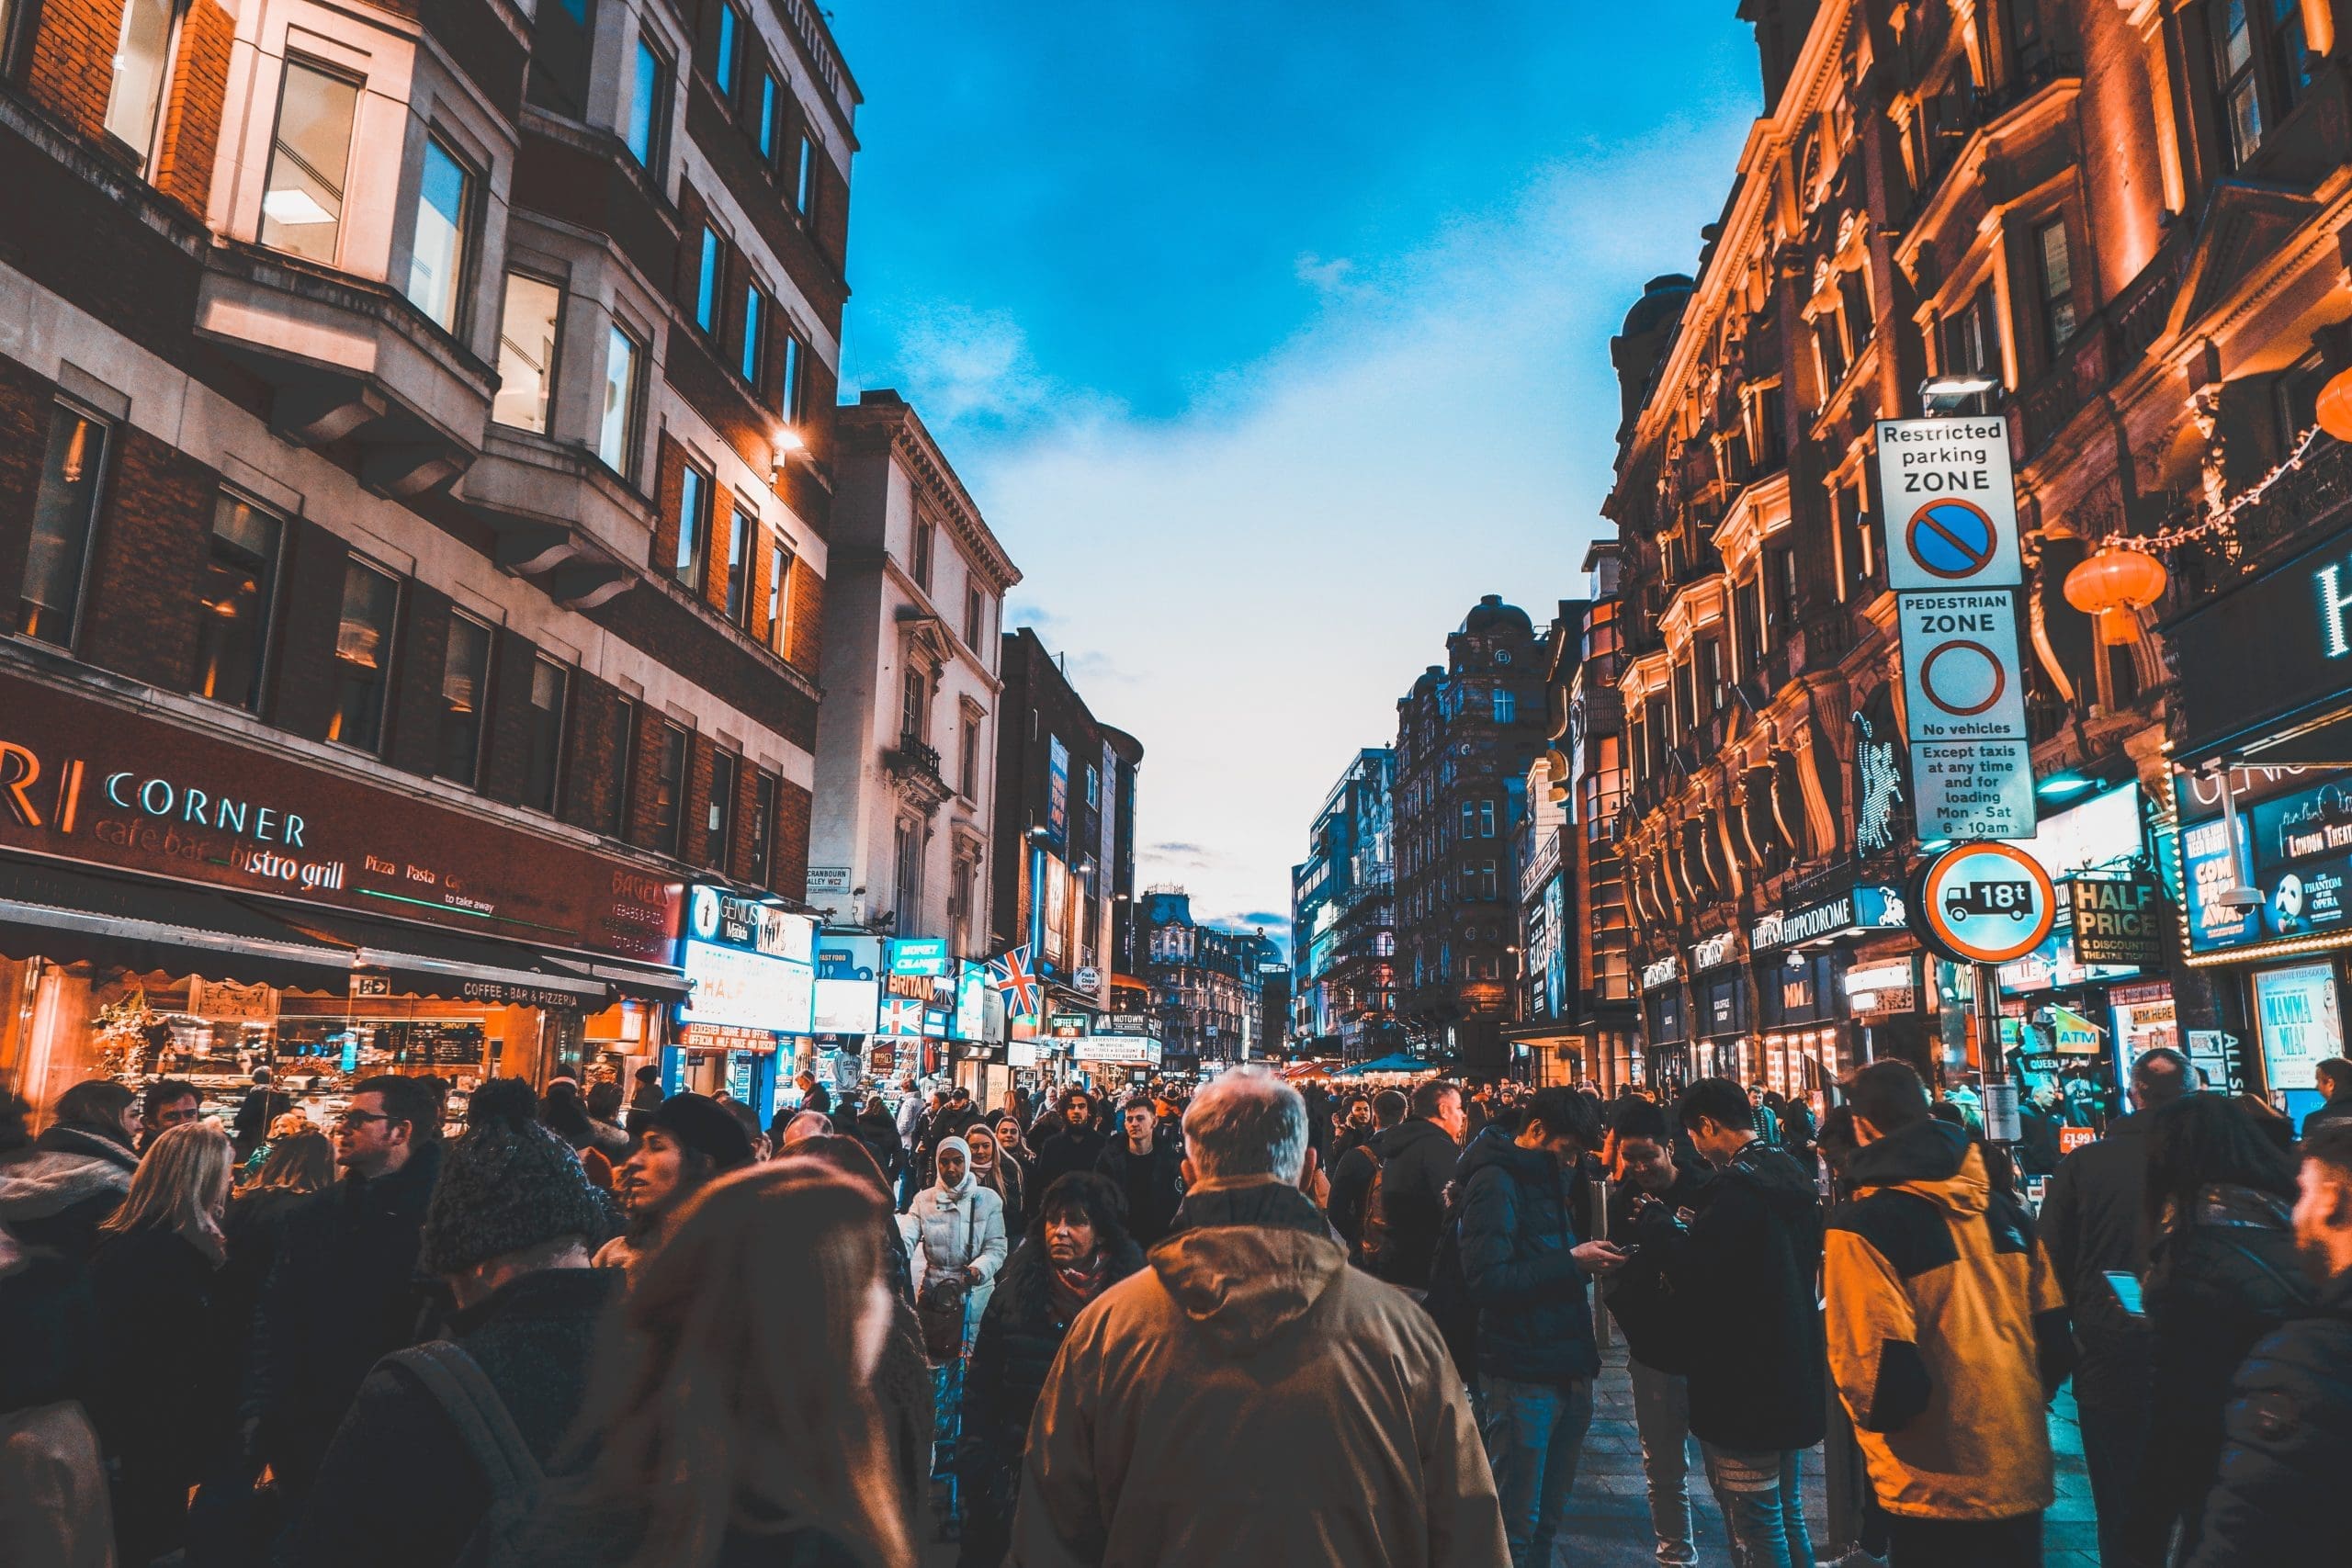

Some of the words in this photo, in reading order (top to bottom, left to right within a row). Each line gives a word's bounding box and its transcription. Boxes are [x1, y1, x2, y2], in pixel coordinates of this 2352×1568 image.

[1884, 423, 2001, 443] Restricted
[1903, 447, 1986, 467] parking
[1905, 470, 1990, 492] ZONE
[1905, 596, 2007, 610] PEDESTRIAN
[1921, 614, 1995, 633] ZONE
[1924, 724, 1945, 736] No
[1950, 723, 2010, 735] vehicles
[1923, 747, 1974, 760] Except
[1980, 745, 2016, 757] taxis
[1928, 762, 1943, 773] at
[1949, 763, 1974, 776] any
[1980, 761, 2013, 772] time
[1945, 777, 1972, 788] and
[1977, 776, 1999, 787] for
[1945, 792, 2001, 806] loading
[106, 773, 304, 847] CORNER
[1937, 807, 1969, 818] Mon
[1986, 807, 2012, 818] Sat
[1943, 822, 1952, 833] 6
[1969, 822, 2009, 833] 10am
[96, 818, 158, 848] cafe
[165, 828, 211, 861] bar
[231, 842, 296, 881] bistro
[300, 860, 345, 890] grill
[2288, 831, 2324, 858] LONDON
[365, 855, 395, 875] Pizza
[407, 864, 435, 885] Pasta
[2196, 856, 2234, 885] COM
[2304, 876, 2343, 895] PHANTOM
[445, 894, 455, 904] to
[456, 896, 473, 908] take
[474, 899, 494, 914] away
[1981, 884, 2027, 908] 18t
[2076, 883, 2153, 911] HALF
[2312, 896, 2339, 910] OPERA
[719, 896, 758, 925] GENIUS
[1784, 897, 1850, 943] HIPPODROME
[2201, 904, 2243, 928] AWA
[2078, 912, 2157, 936] PRICE
[2082, 941, 2090, 950] &
[2082, 952, 2122, 961] THEATRE
[464, 981, 502, 998] COFFEE
[510, 988, 527, 1001] BAR
[531, 991, 537, 1002] &
[539, 991, 578, 1008] PIZZERIA
[888, 973, 934, 1002] BRITAIN
[1114, 1014, 1144, 1023] MOTOWN
[2133, 1010, 2149, 1022] ATM
[2152, 1007, 2174, 1021] HERE
[2266, 994, 2312, 1026] MAMMA
[1053, 1018, 1073, 1027] COFFEE
[1073, 1019, 1084, 1027] BAR
[1061, 1027, 1075, 1036] OPEN
[2061, 1031, 2096, 1043] ATM
[2223, 1033, 2242, 1073] ALL
[2030, 1059, 2059, 1069] QUEEN
